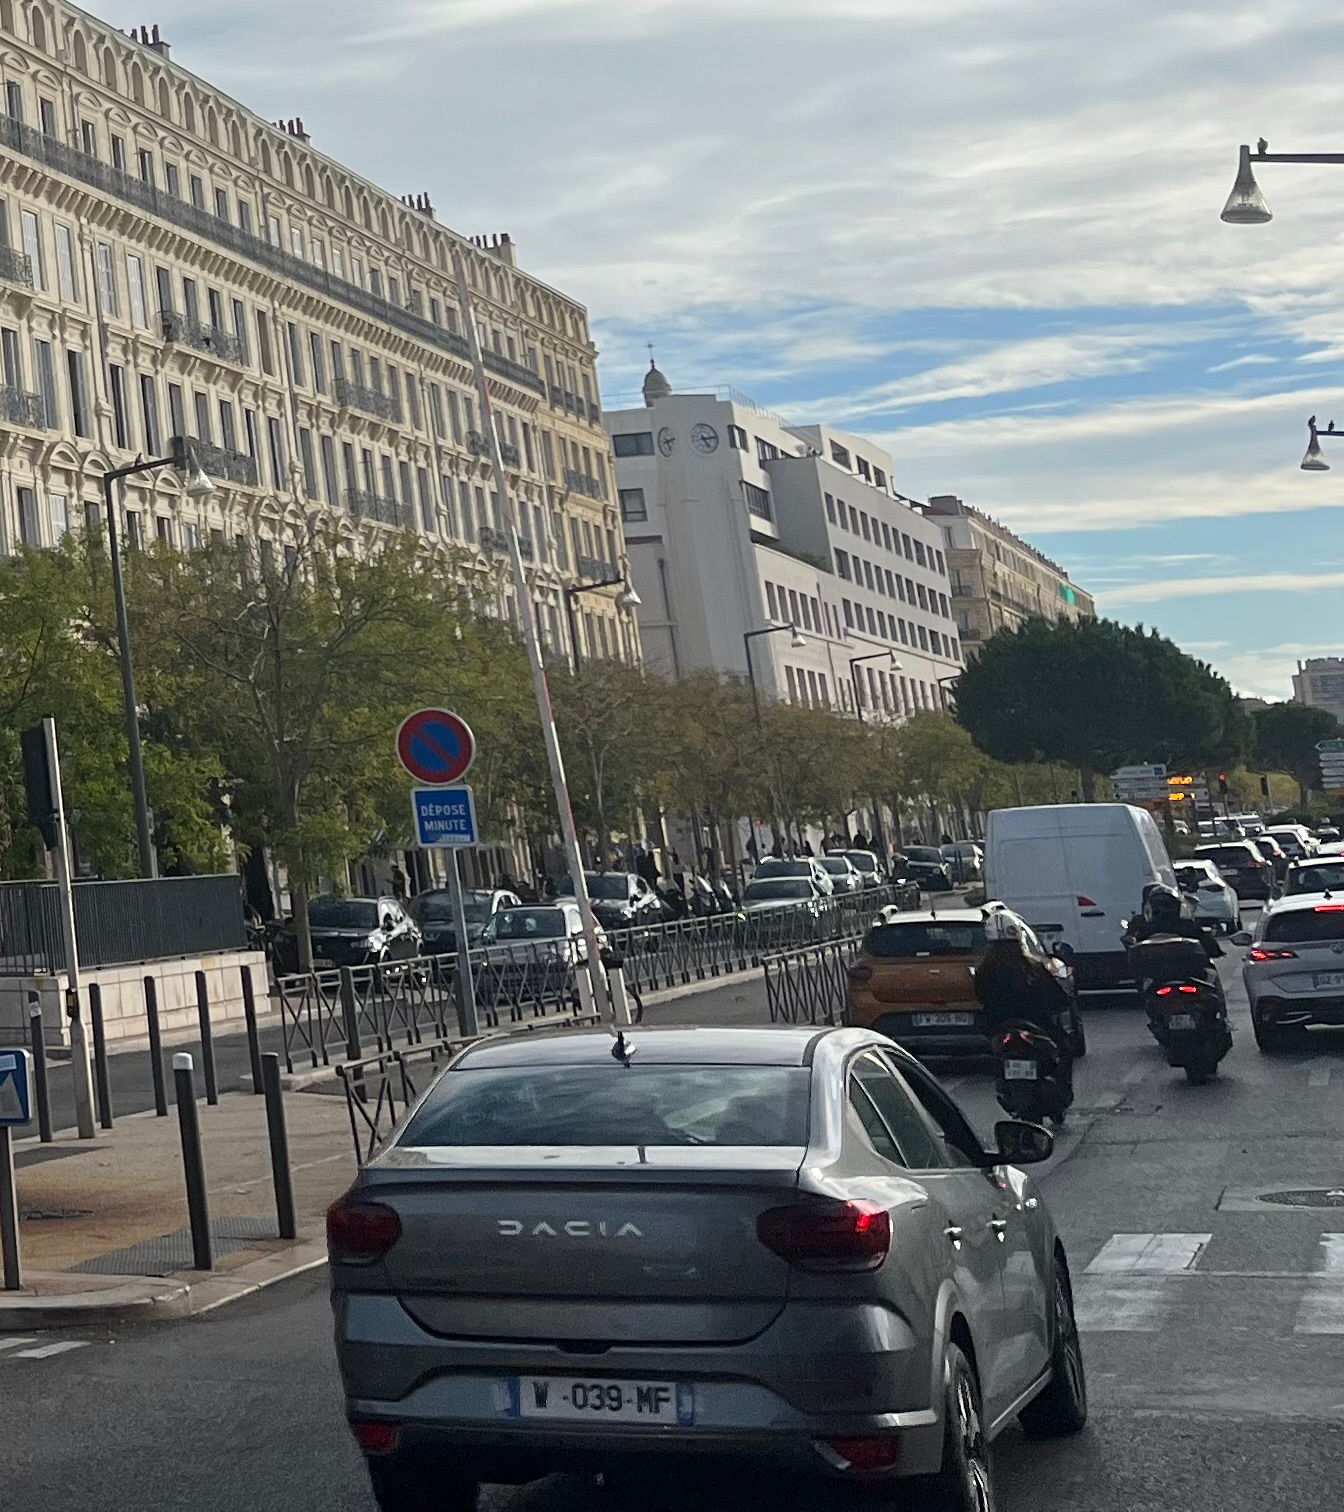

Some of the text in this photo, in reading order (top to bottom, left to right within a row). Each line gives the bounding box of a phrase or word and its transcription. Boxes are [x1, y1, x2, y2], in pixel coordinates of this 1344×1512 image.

[421, 803, 466, 817] DÉPOSE
[424, 820, 467, 832] MINUTE
[497, 1220, 643, 1236] DACIA
